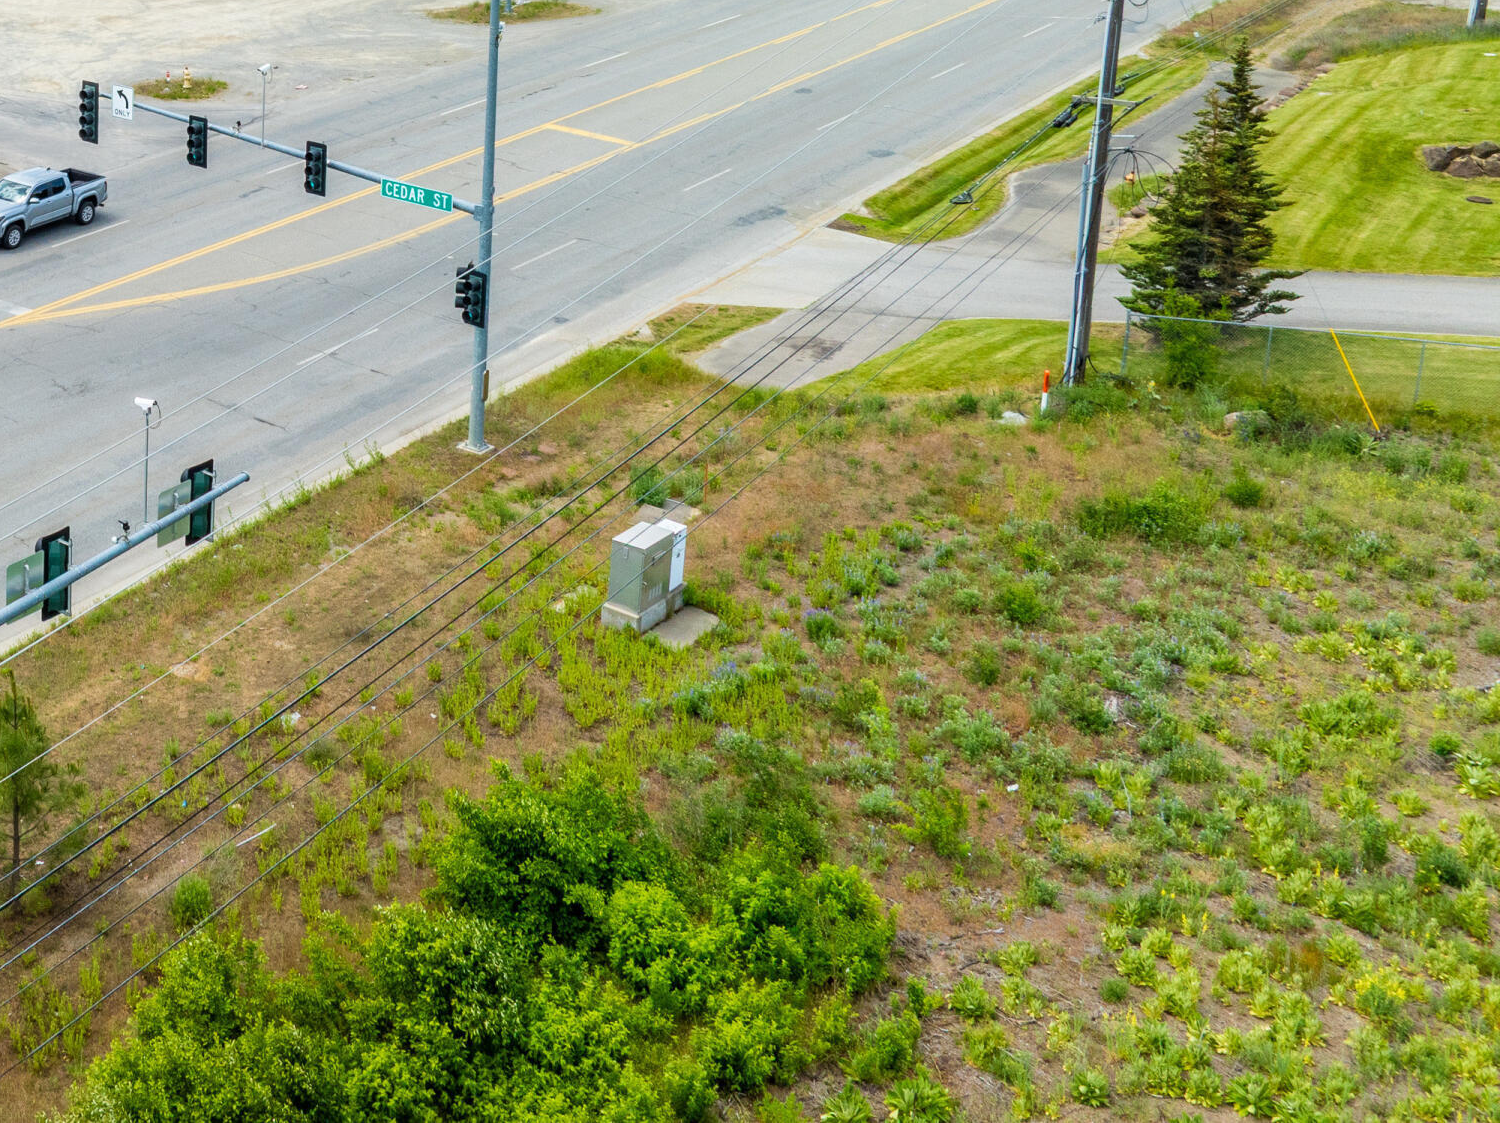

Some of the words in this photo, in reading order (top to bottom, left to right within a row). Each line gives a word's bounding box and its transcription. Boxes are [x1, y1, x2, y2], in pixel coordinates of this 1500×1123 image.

[114, 108, 130, 117] ONLY
[385, 182, 425, 204] CEDAR
[432, 193, 449, 209] ST
